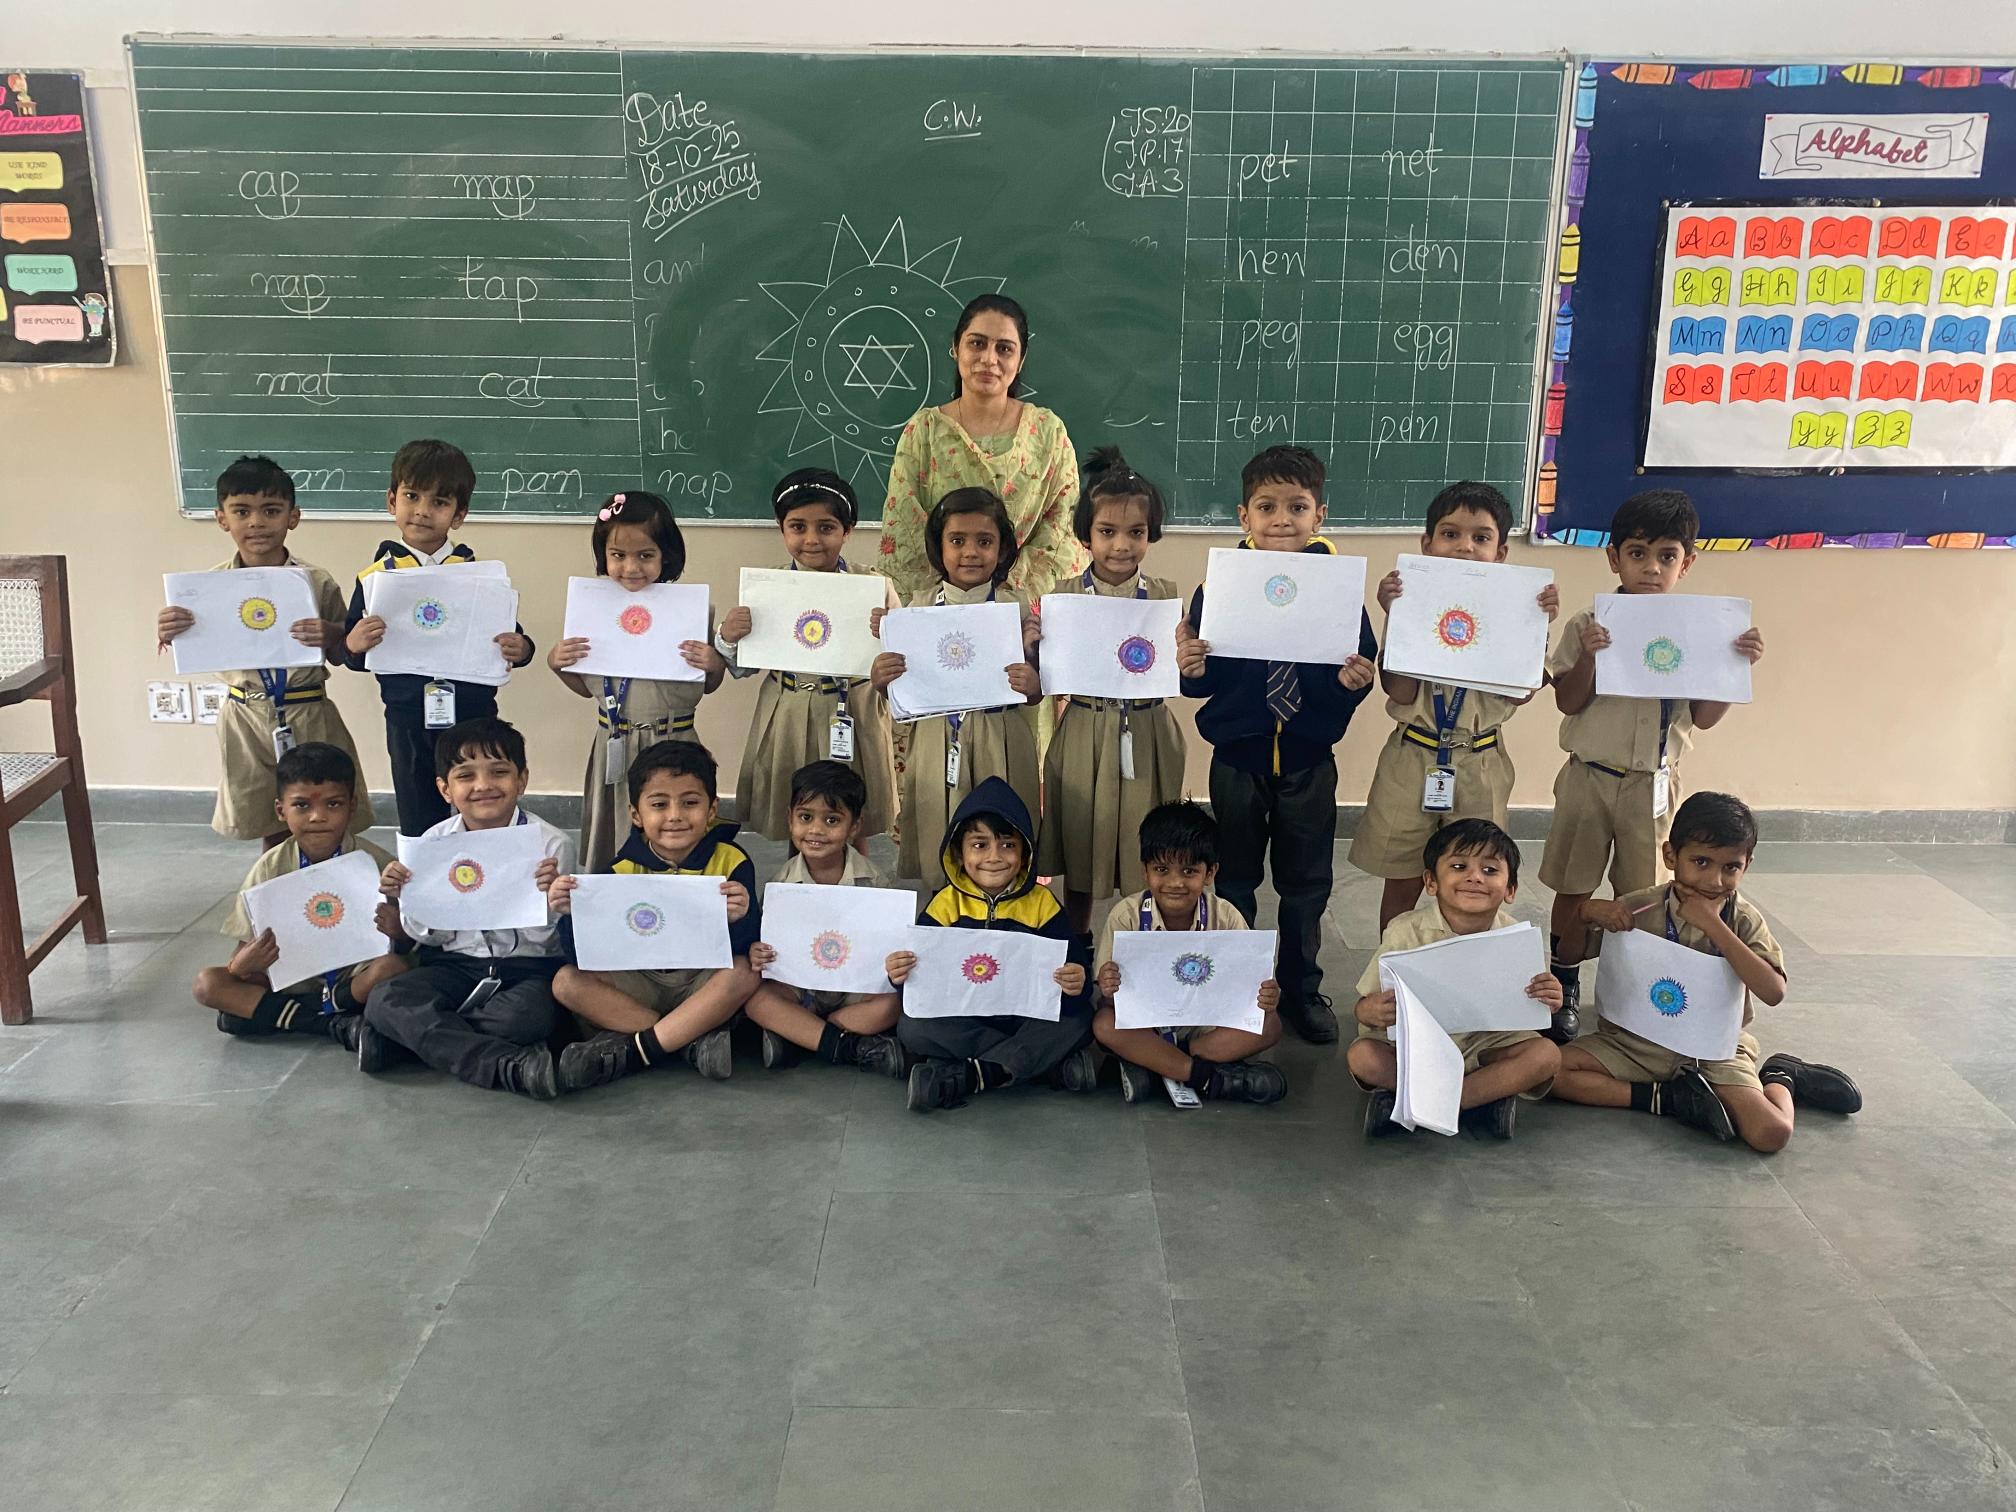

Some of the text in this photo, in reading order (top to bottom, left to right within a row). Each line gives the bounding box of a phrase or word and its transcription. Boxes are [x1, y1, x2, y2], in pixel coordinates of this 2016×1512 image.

[625, 91, 712, 147] Date
[1799, 126, 1928, 164] Alphabet
[638, 120, 740, 190] 18-10-25
[1239, 132, 1443, 202] pet net
[238, 169, 536, 221] cap map
[642, 161, 762, 229] Saturday
[1238, 223, 1458, 281] hen den
[250, 255, 538, 323] nap tap
[1236, 319, 1454, 370] peg egg
[255, 352, 545, 406] mat cat
[1227, 399, 1438, 460] ten pen
[501, 467, 583, 510] pan
[657, 469, 733, 509] nap
